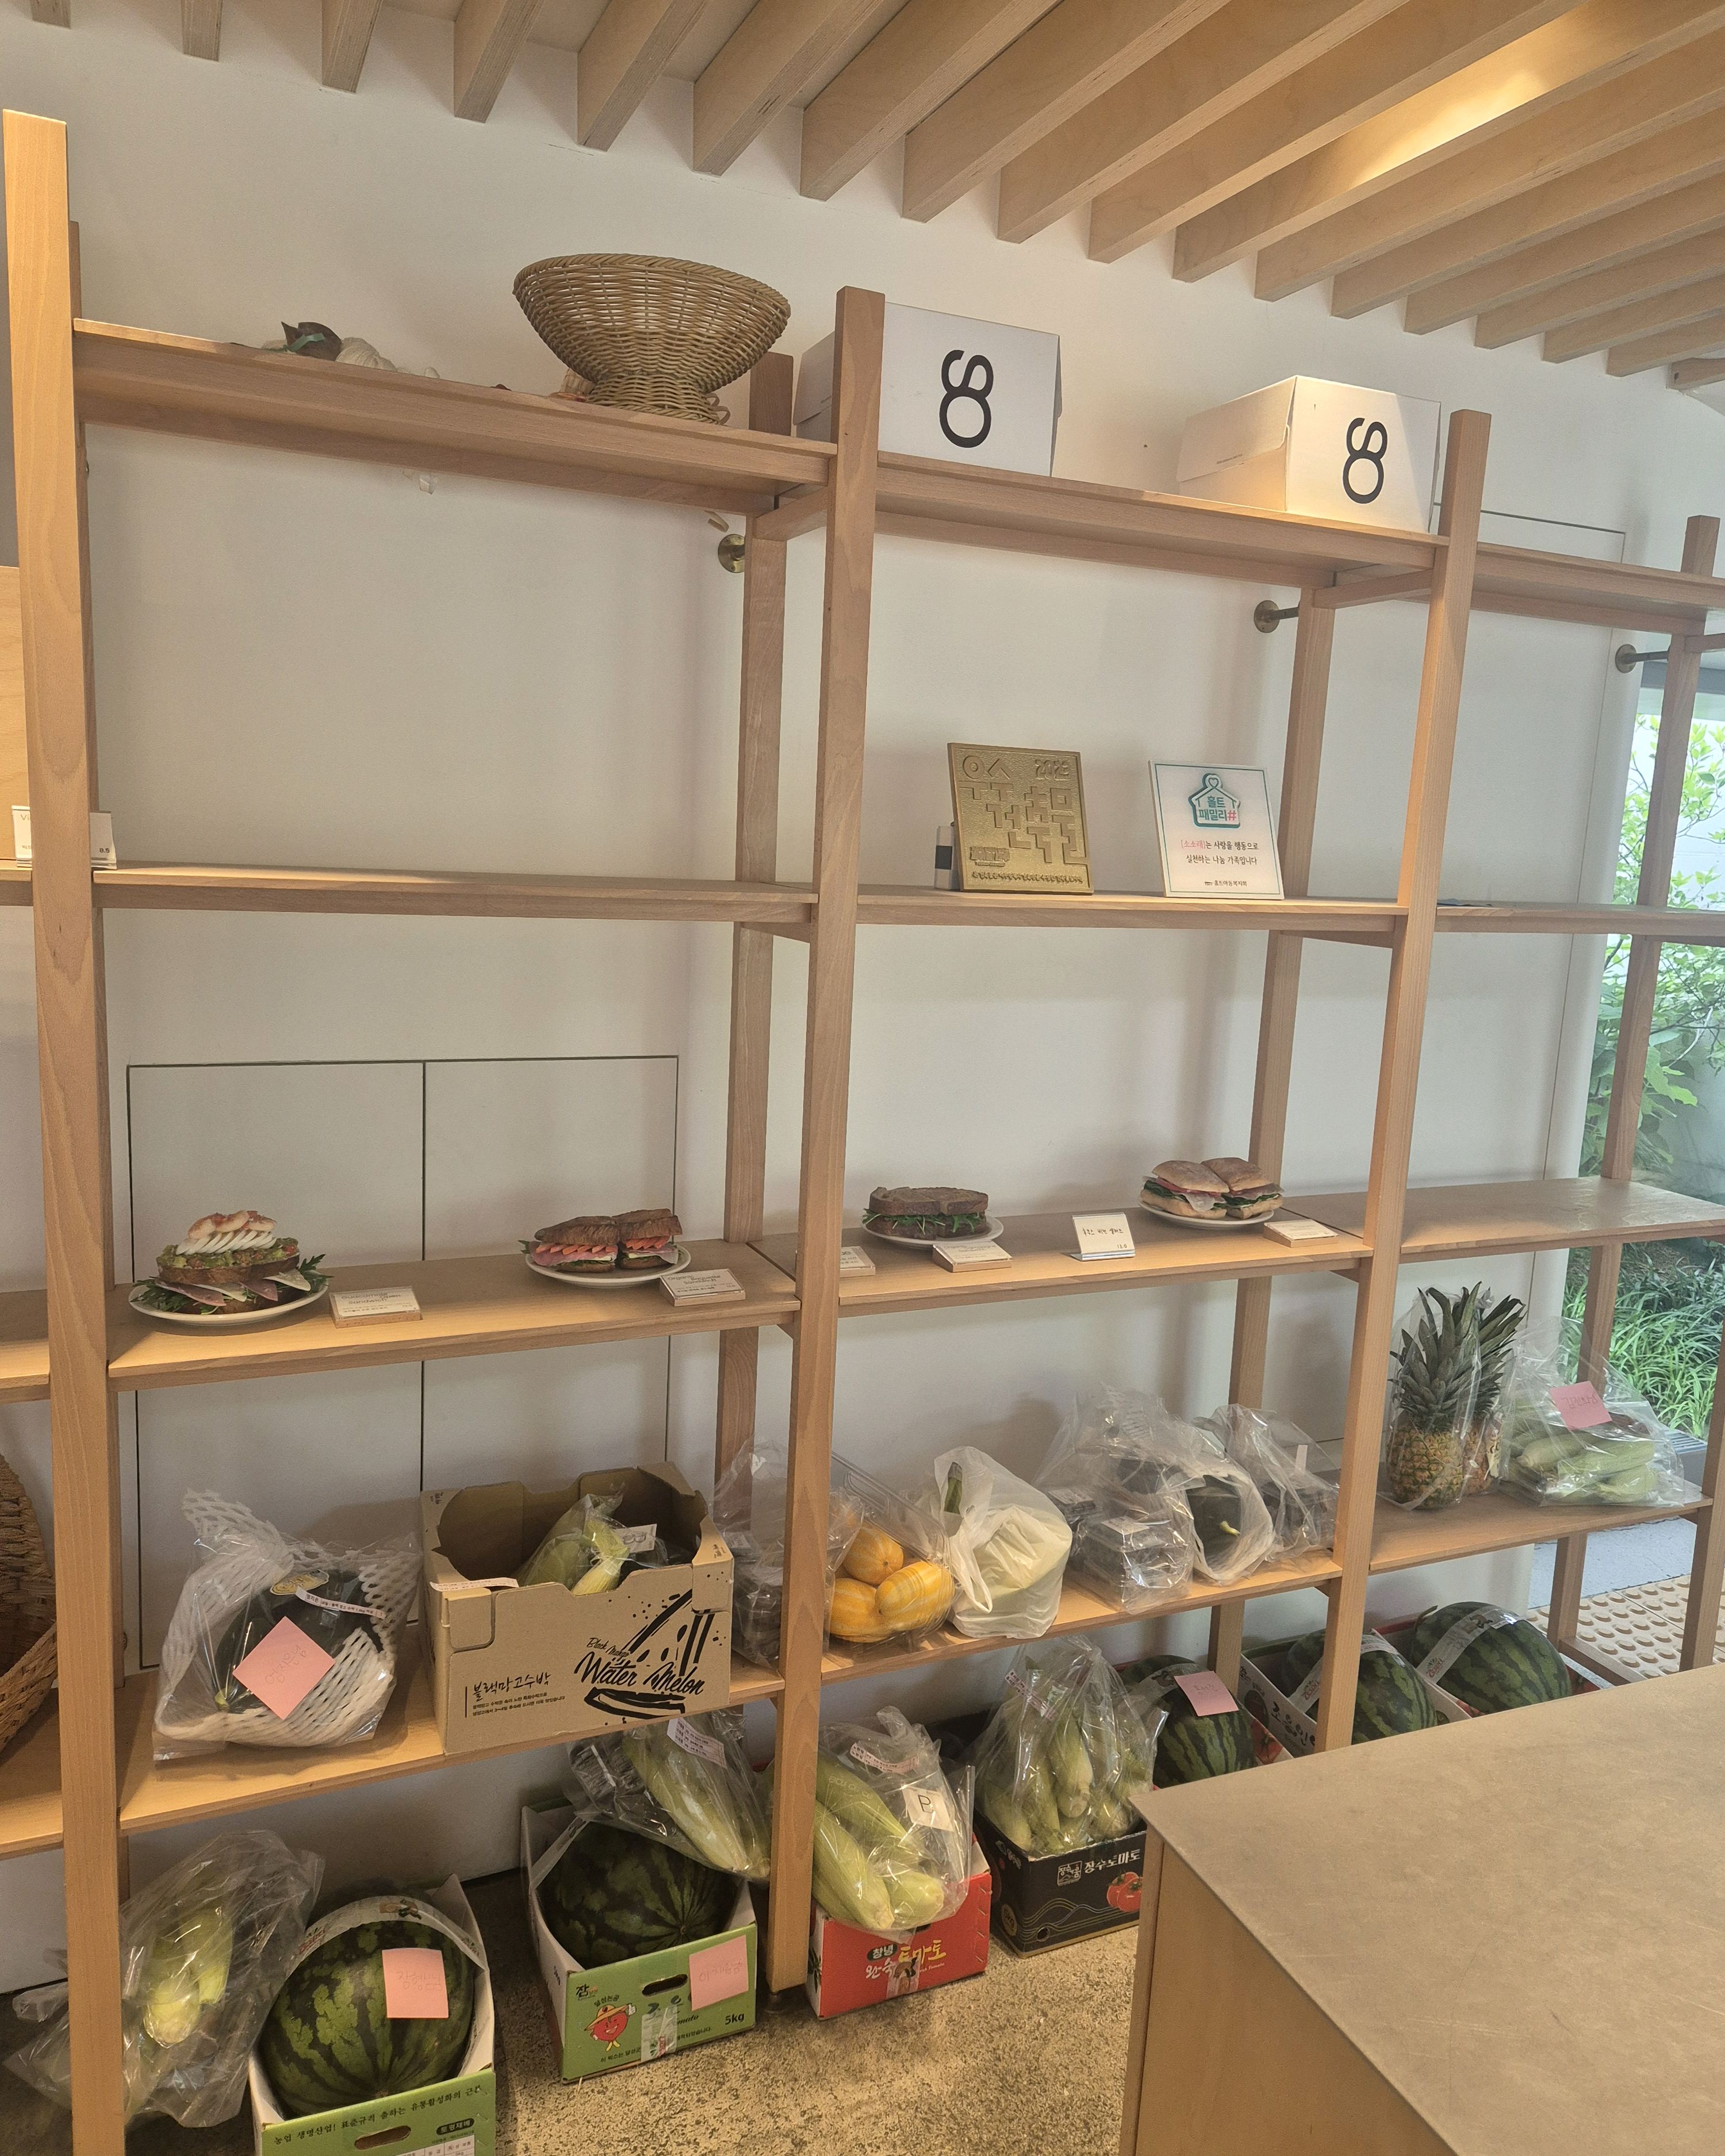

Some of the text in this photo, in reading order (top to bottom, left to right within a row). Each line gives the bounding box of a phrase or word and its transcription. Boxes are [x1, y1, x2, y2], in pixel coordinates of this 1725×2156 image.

[1207, 795, 1226, 808] 홀트
[1214, 841, 1233, 850] 사랑을
[1234, 842, 1259, 851] 행동으로
[1186, 854, 1257, 865] 실천하는 나눔 가족입니다
[586, 1637, 630, 1661] Black Mango
[574, 1651, 705, 1695] Water Melon
[473, 1671, 551, 1702] 블랙망고수박
[1084, 1849, 1141, 1874] 장수토마토
[873, 1944, 894, 1959] 창녕
[898, 1939, 947, 1965] 토마토
[865, 1957, 896, 1979] 완숙
[725, 2013, 745, 2025] 5kg
[274, 2135, 292, 2145] 농업
[297, 2124, 336, 2140] 생명산업!
[341, 2113, 375, 2130] 표준규격
[381, 2108, 405, 2120] 출하는
